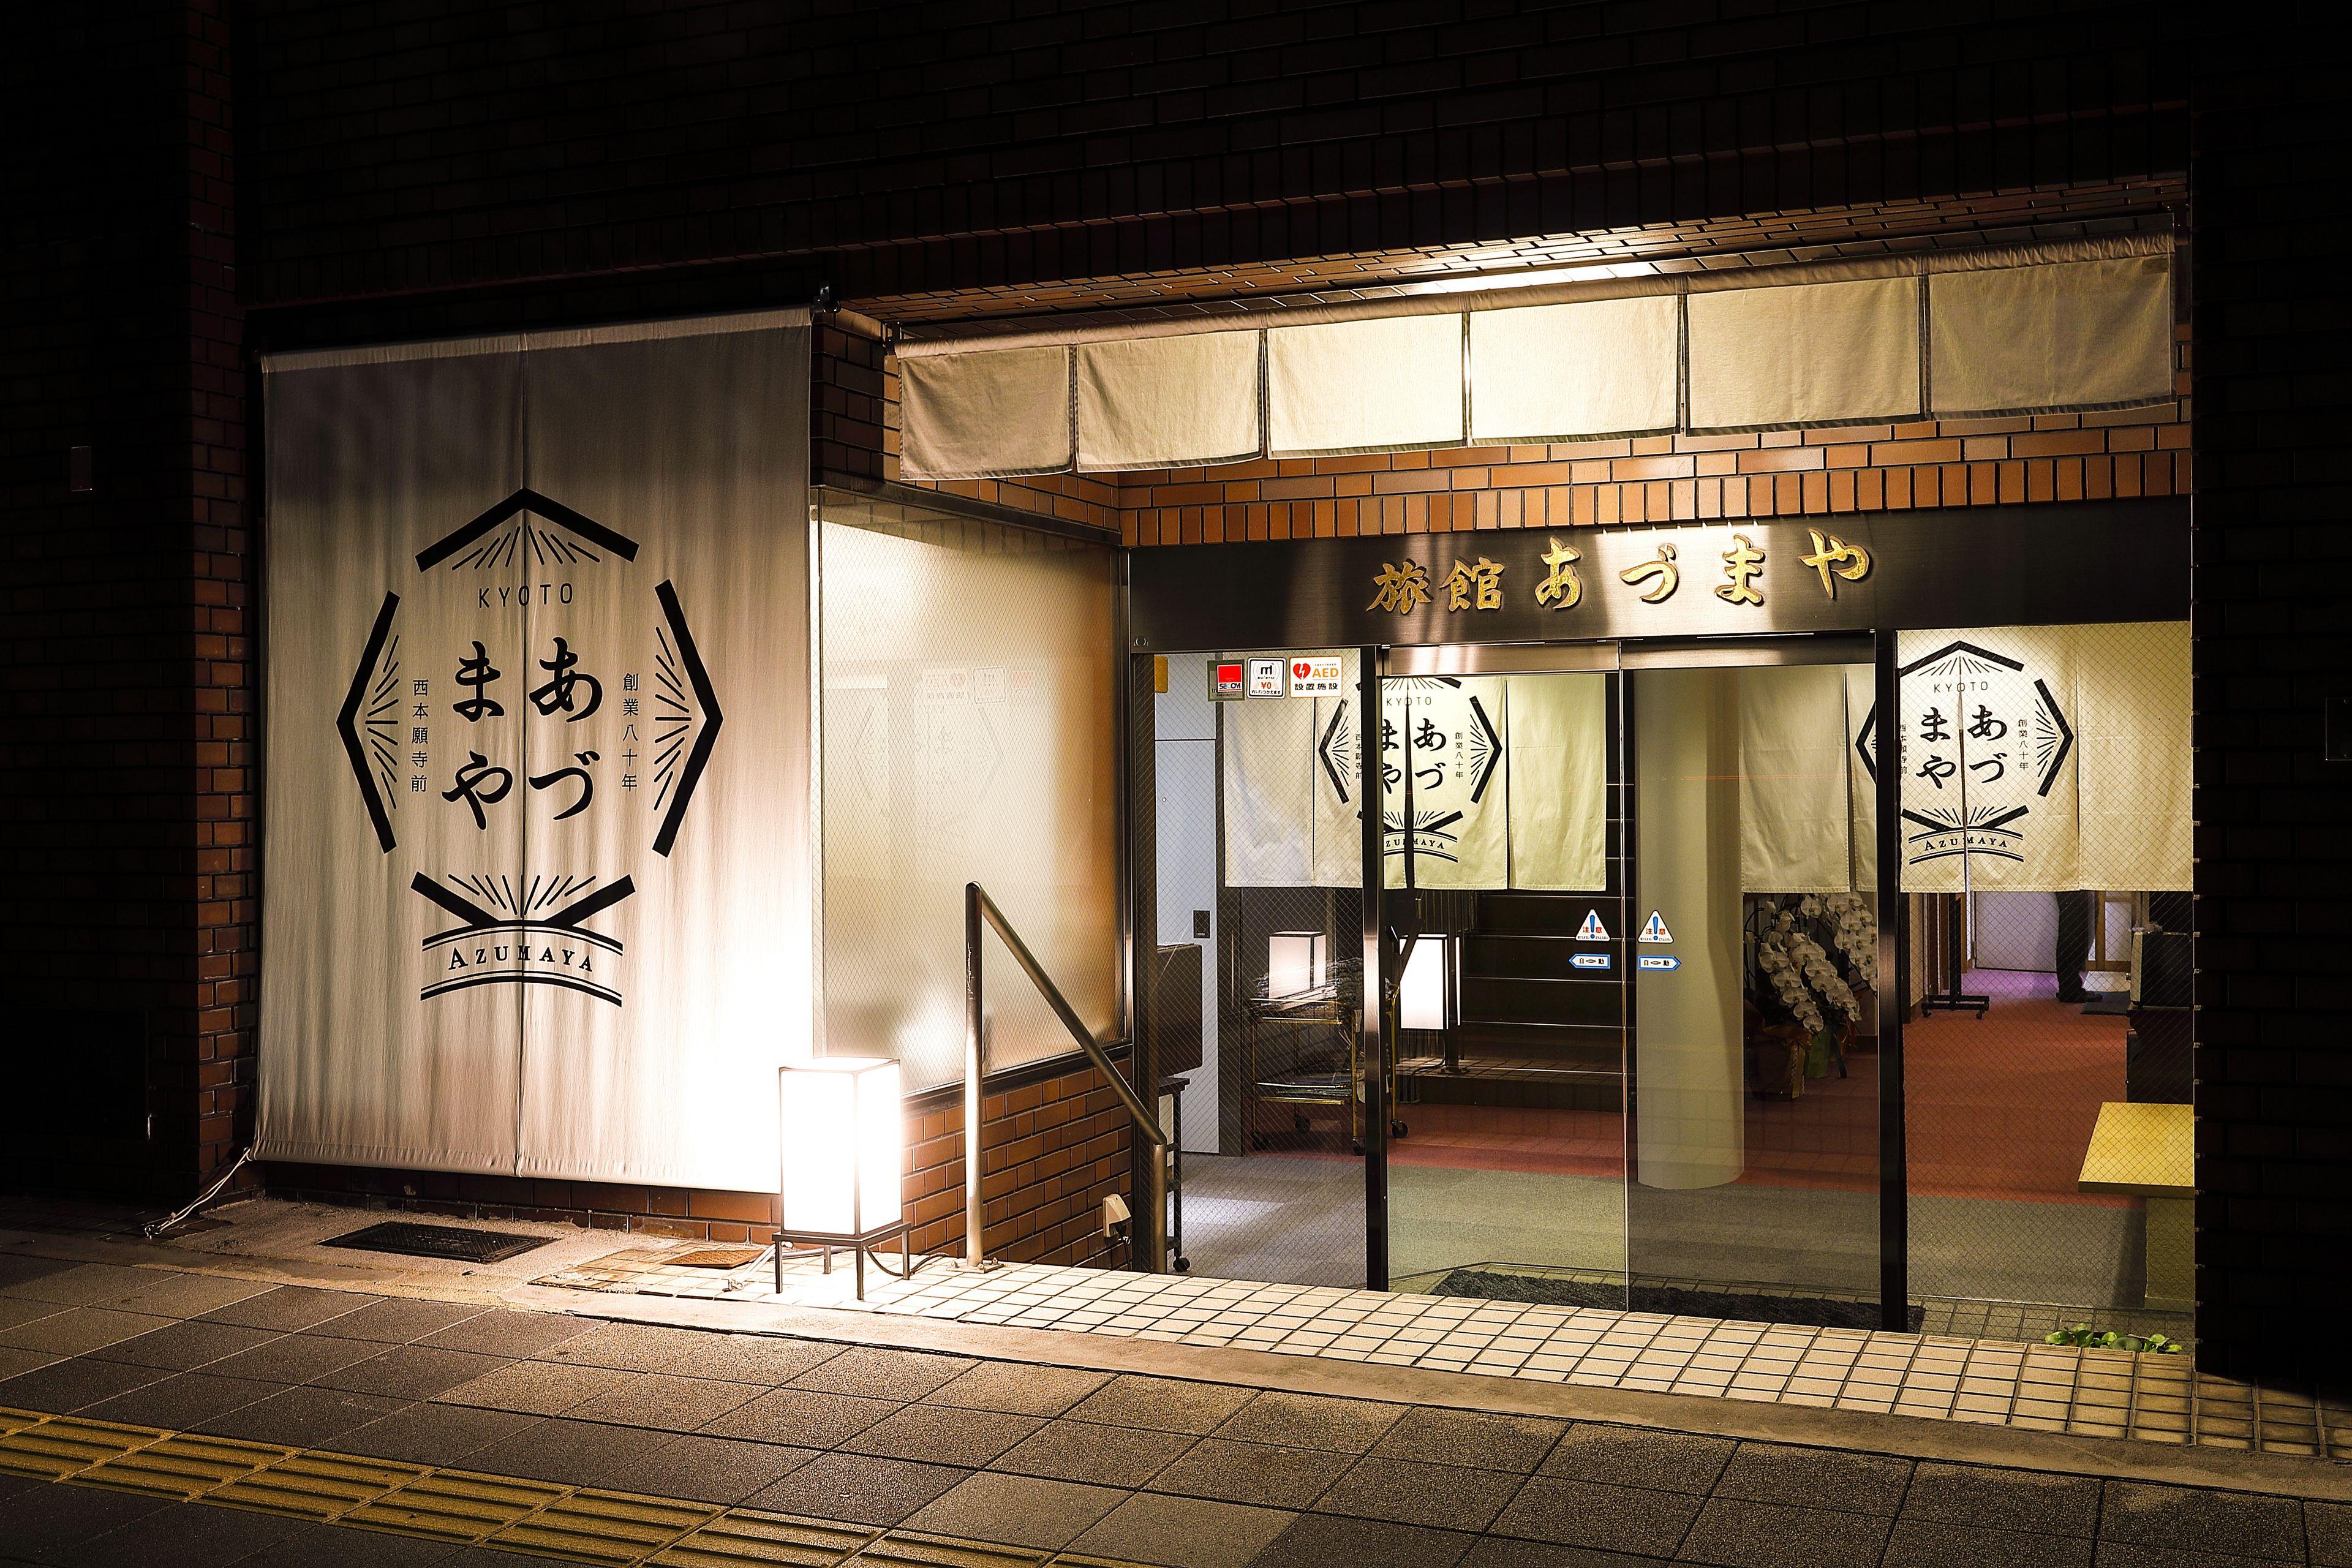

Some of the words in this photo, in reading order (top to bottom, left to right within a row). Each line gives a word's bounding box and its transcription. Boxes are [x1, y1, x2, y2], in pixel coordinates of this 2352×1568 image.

[478, 583, 573, 608] KYOTO
[1366, 557, 1505, 614] 旅館
[1534, 529, 1872, 608] あづまや
[1313, 668, 1339, 678] AED
[1934, 681, 1989, 693] KYOTO
[1387, 696, 1432, 706] KYOTO
[411, 679, 429, 792] 西本願寺前
[441, 641, 513, 830] まや
[529, 637, 603, 820] あづ
[622, 673, 638, 792] 創業八十年
[1455, 732, 1464, 778] 創業八十年
[1916, 707, 1956, 790] まや
[1967, 704, 2008, 783] あづ
[2018, 719, 2029, 770] 創業八十年
[1924, 837, 2008, 851] AZUMAYA
[448, 946, 593, 972] AZUMAYA
